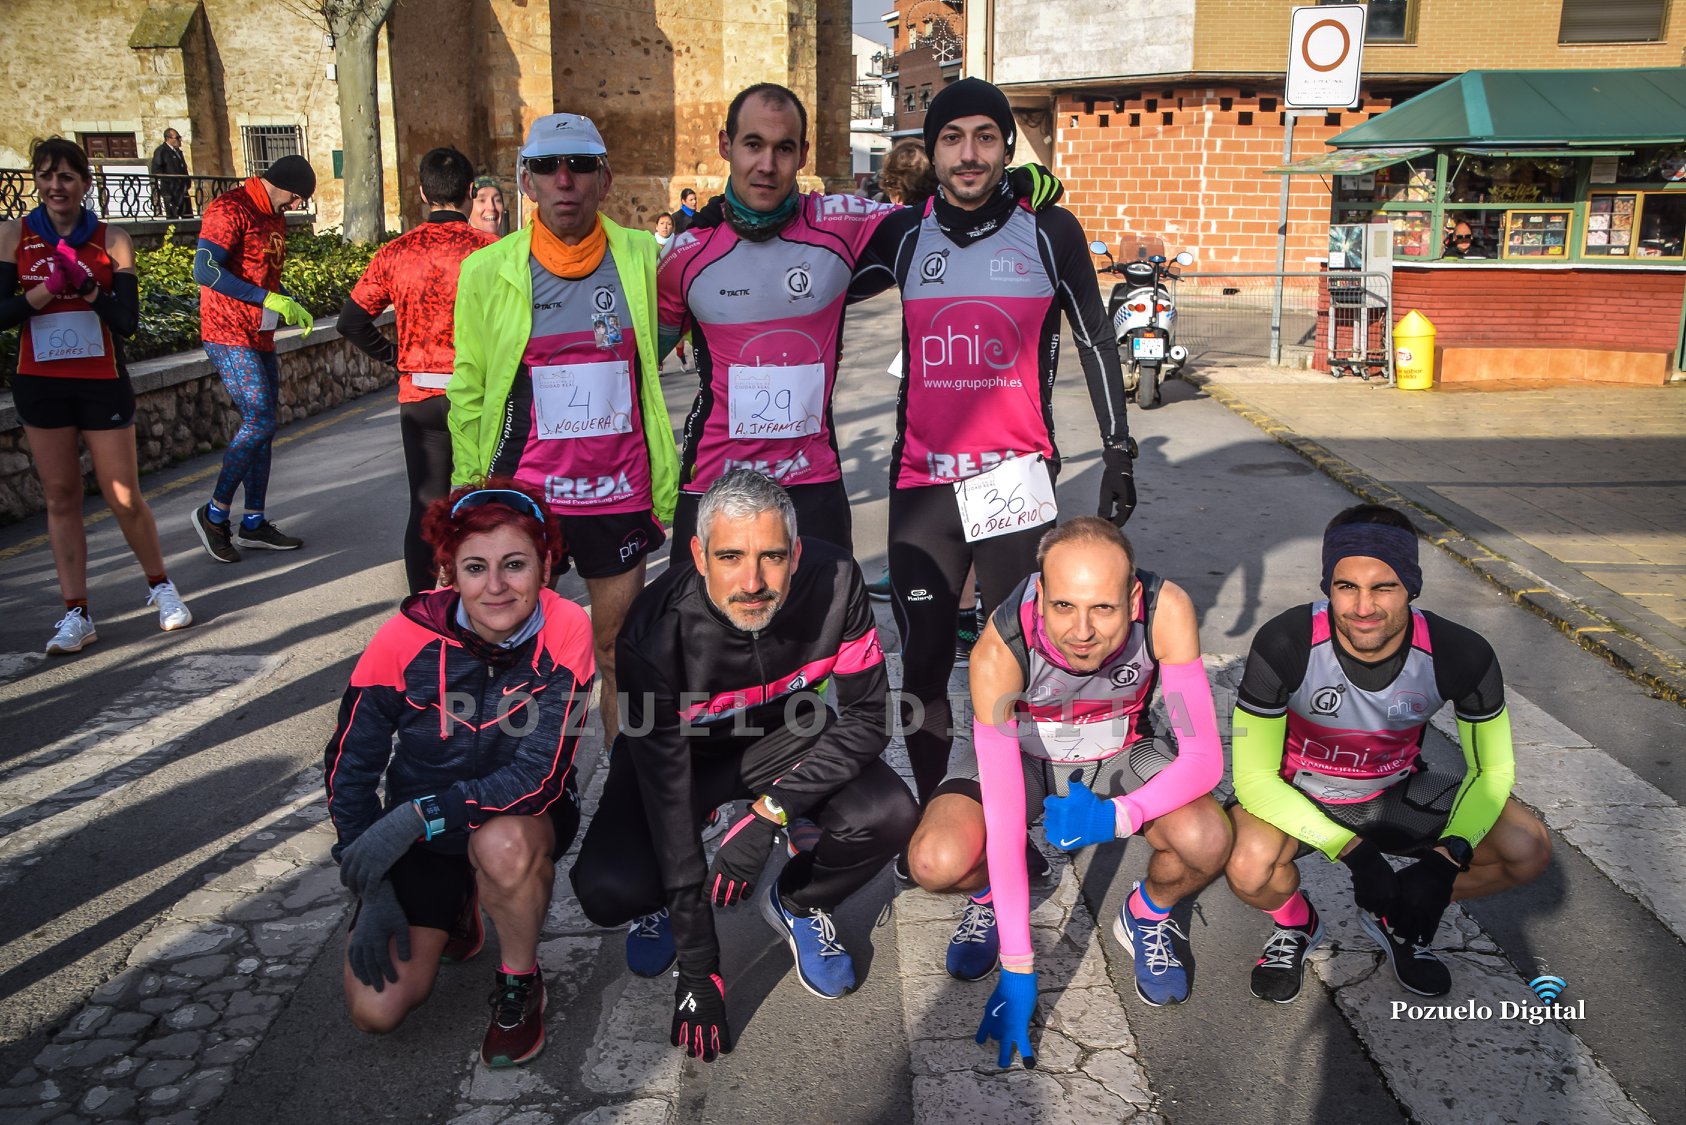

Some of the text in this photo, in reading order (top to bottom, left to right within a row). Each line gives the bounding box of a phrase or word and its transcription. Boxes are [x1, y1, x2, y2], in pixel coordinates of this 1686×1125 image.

[48, 328, 79, 349] 60
[48, 347, 84, 357] FLORES
[921, 324, 980, 378] phi
[923, 376, 1023, 391] www.grupophi.es
[567, 386, 591, 420] 4
[750, 389, 791, 422] 29
[554, 415, 611, 435] NOGUERA
[749, 419, 805, 435] INFANTE
[983, 482, 1025, 519] 36
[985, 516, 1012, 533] DEL
[1017, 508, 1037, 526] RIO
[1387, 699, 1412, 718] phi
